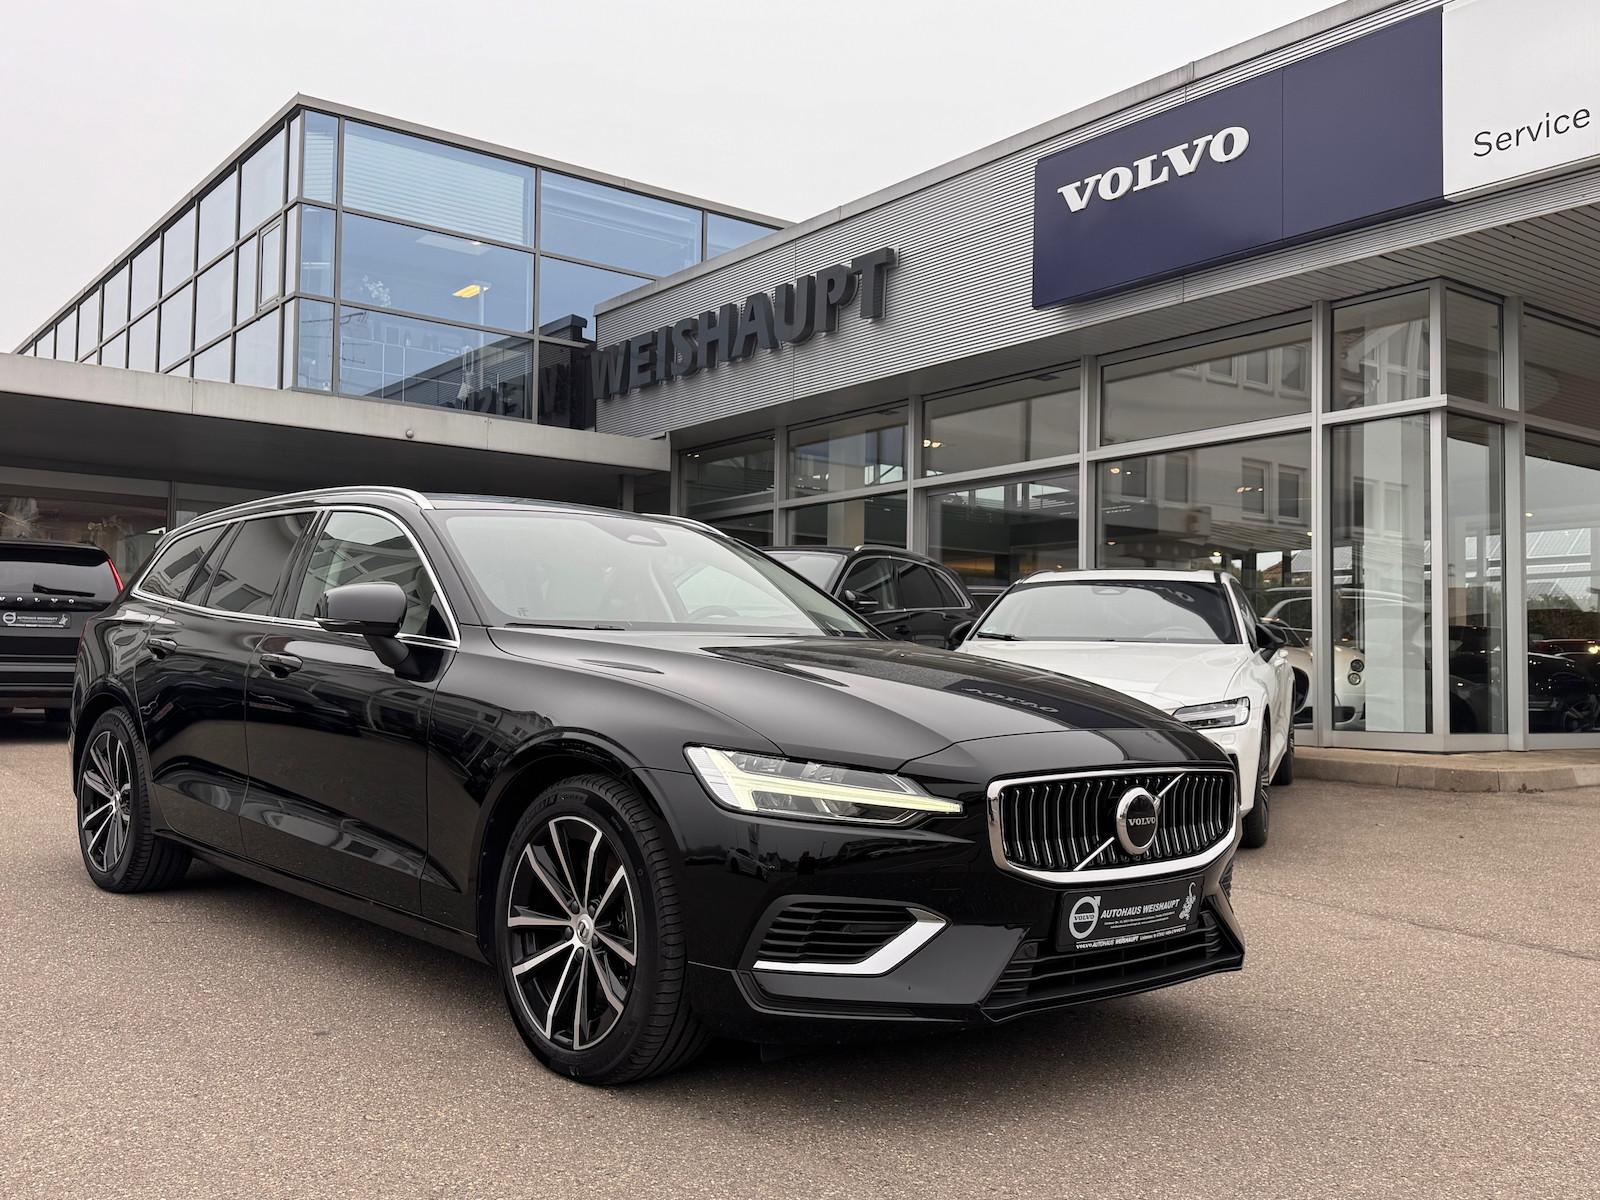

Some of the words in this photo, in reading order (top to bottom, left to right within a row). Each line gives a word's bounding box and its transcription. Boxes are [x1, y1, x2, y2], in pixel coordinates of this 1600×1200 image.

[1473, 107, 1591, 158] Service
[1057, 126, 1250, 213] VOLVO
[590, 247, 896, 401] WEISHAUPT
[1128, 817, 1156, 826] VOLVO
[1100, 905, 1142, 919] AUTOHAUS
[1142, 899, 1181, 914] WEISHAUPT
